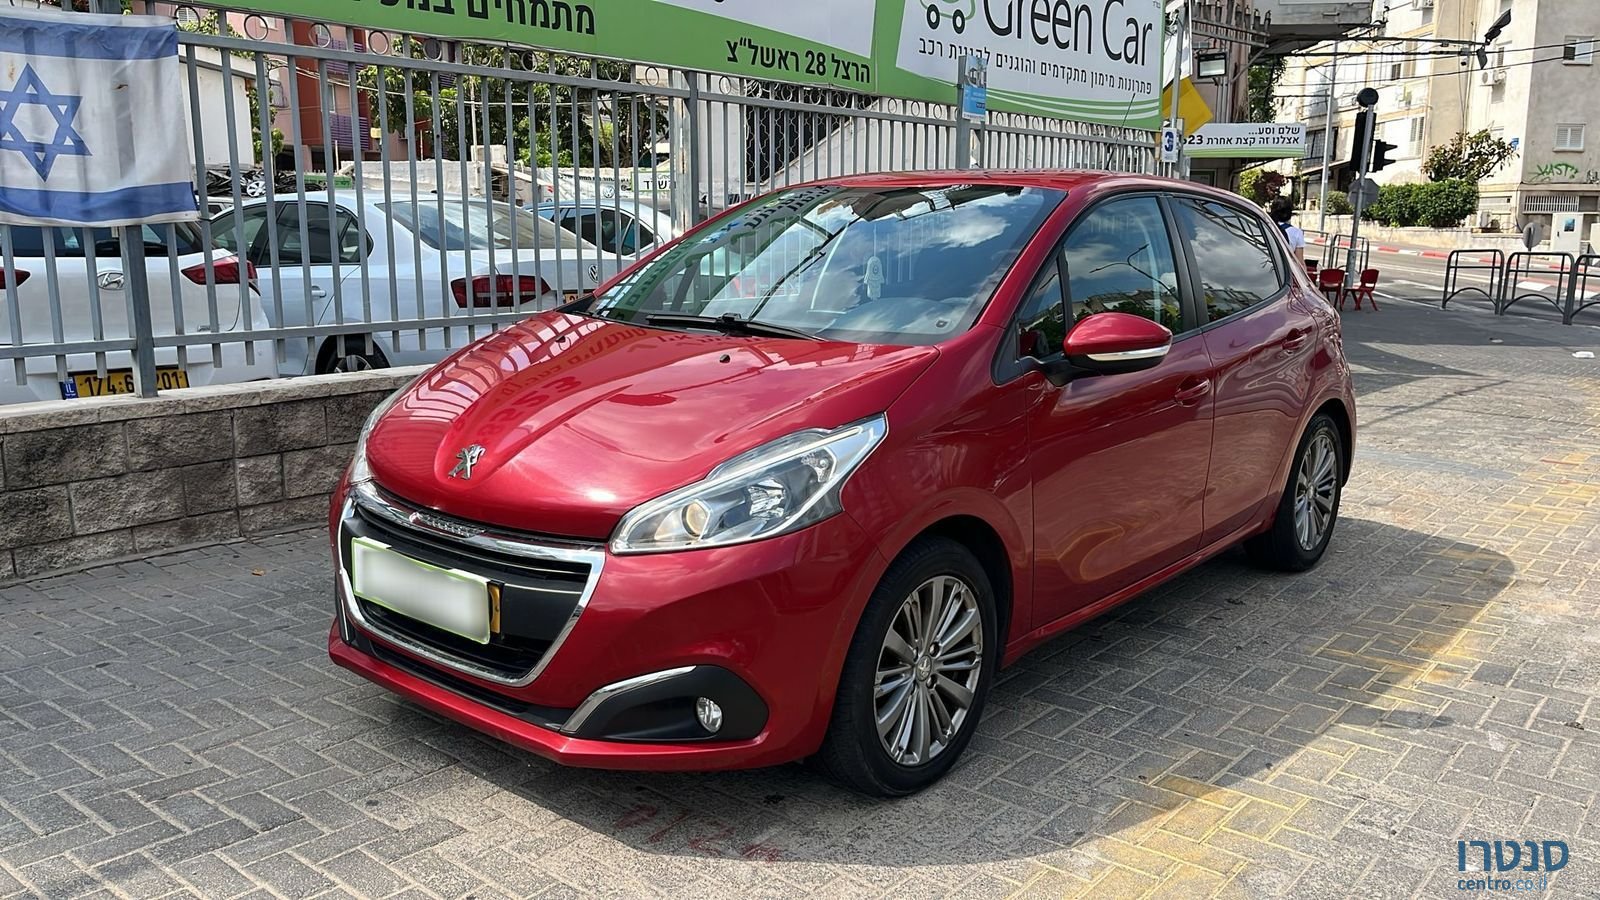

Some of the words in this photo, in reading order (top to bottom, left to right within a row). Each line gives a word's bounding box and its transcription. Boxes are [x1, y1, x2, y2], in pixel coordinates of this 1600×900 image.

[983, 0, 1092, 54] Green
[1102, 0, 1153, 66] Car
[919, 37, 943, 57] רכב
[805, 50, 826, 76] 28
[831, 53, 870, 83] הרצל
[996, 53, 1036, 74] והוגנים
[1040, 60, 1087, 83] מתקדמים
[1090, 71, 1115, 88] מימון
[1117, 75, 1152, 95] פתרונות
[1206, 136, 1233, 145] אחרת
[1258, 136, 1270, 145] זה
[1272, 136, 1300, 145] אצלנו
[1278, 126, 1300, 135] שלם
[1235, 136, 1256, 147] קצת
